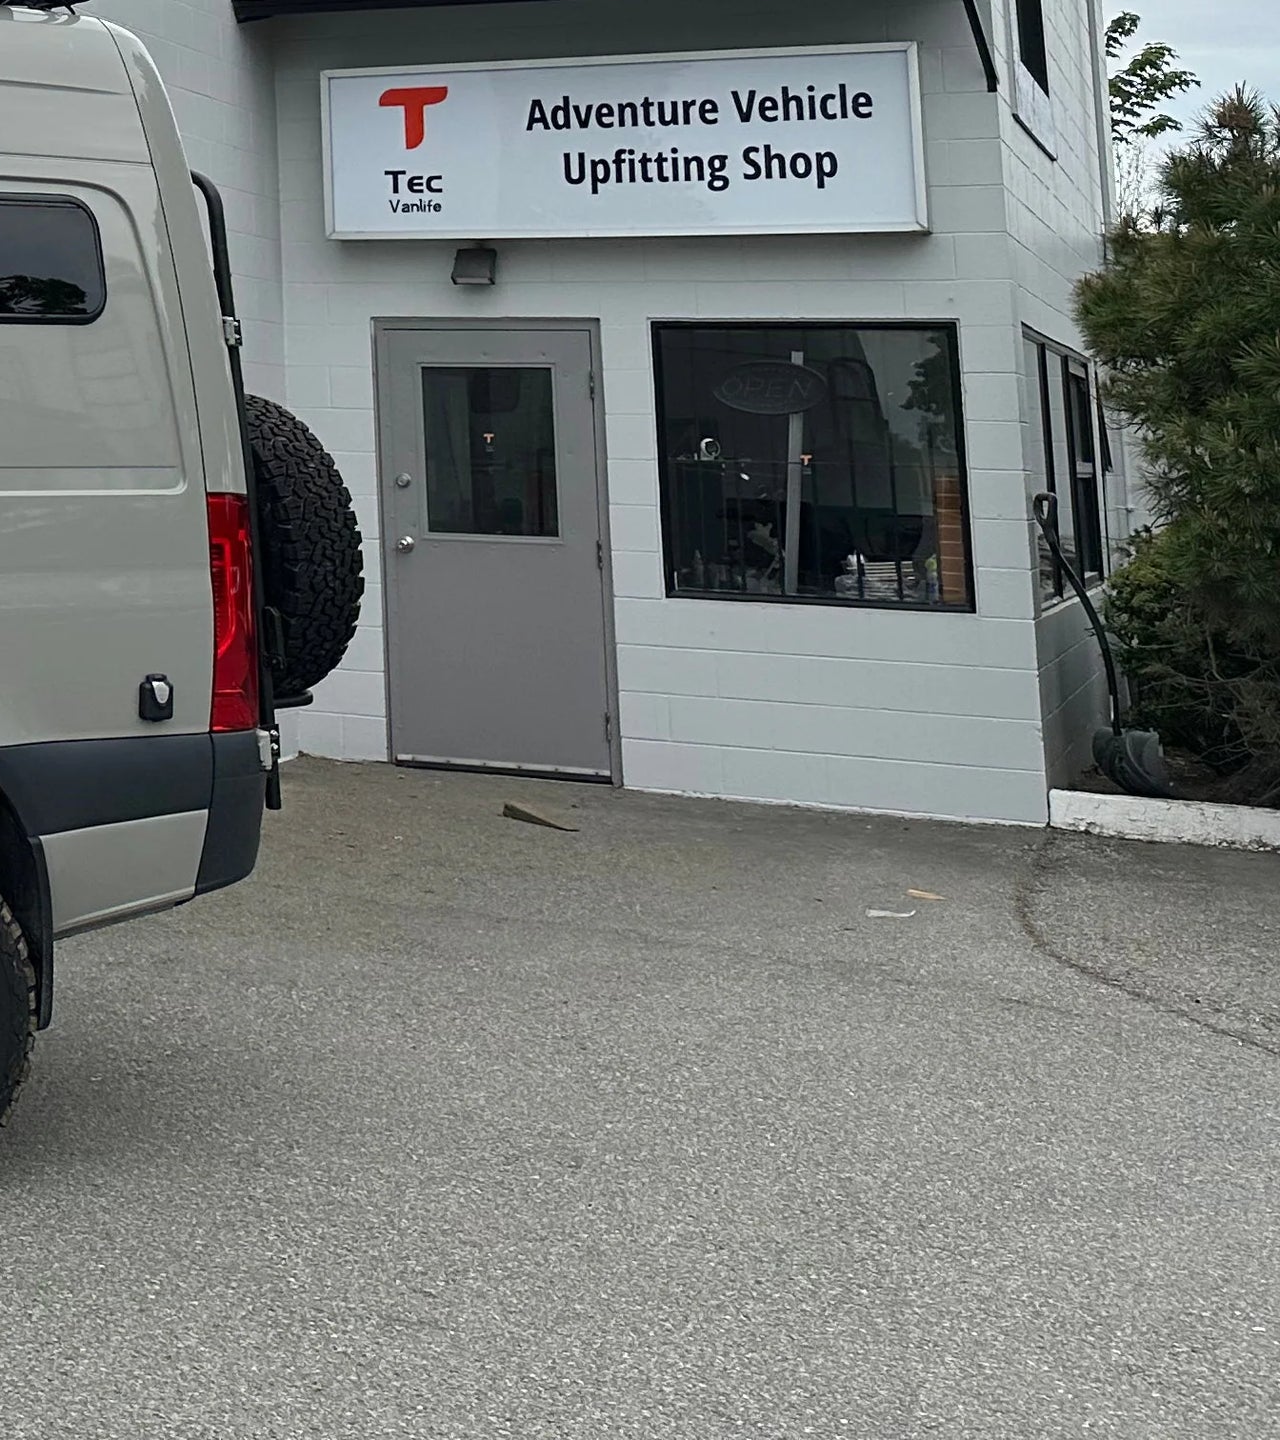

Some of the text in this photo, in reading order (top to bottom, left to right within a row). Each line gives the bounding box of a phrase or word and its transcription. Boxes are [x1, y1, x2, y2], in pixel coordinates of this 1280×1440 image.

[526, 83, 874, 132] Adventure Vehicle
[563, 143, 838, 195] Upfitting Shop
[388, 199, 442, 214] Vanlife
[721, 375, 813, 398] OPEN
